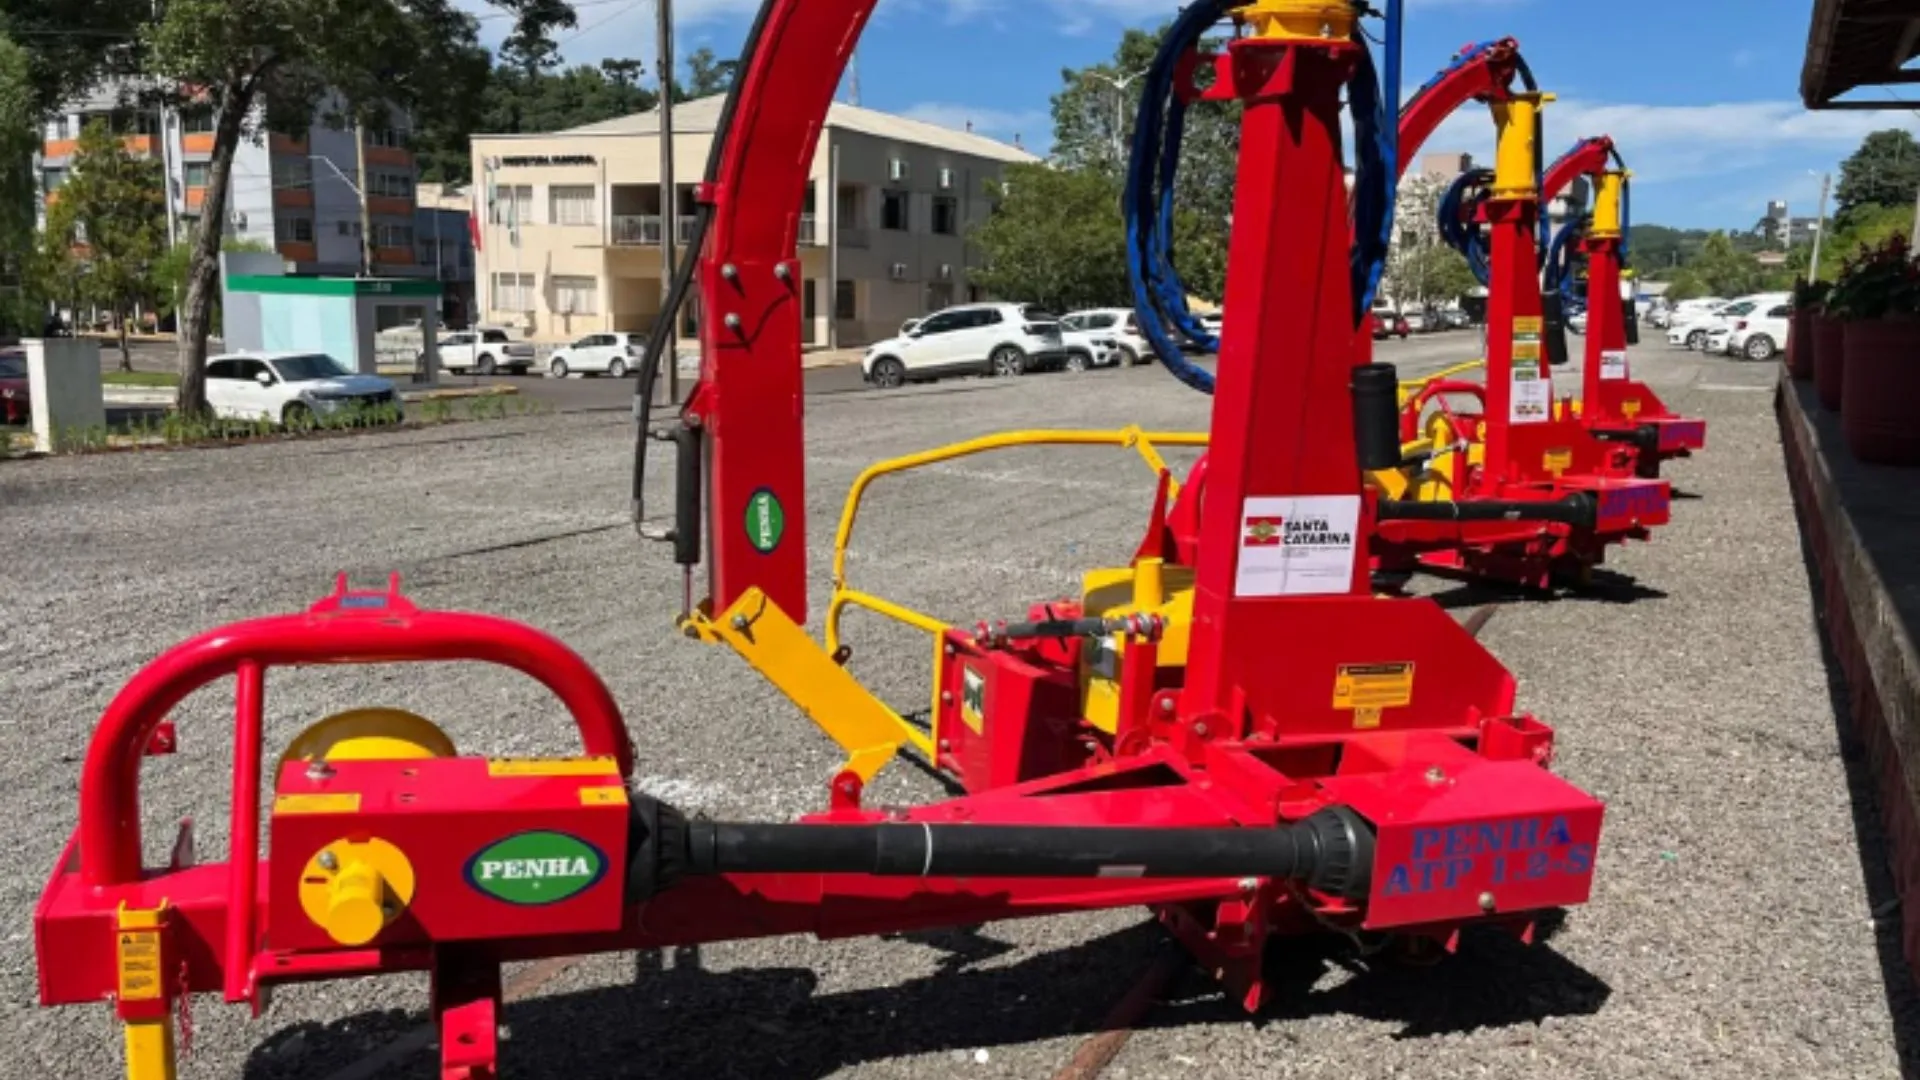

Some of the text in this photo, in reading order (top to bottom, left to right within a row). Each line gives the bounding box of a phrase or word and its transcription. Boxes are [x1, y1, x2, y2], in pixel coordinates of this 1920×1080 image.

[1284, 520, 1329, 532] SANTA
[1283, 533, 1351, 545] CATARINA
[1411, 815, 1572, 859] PENHA
[480, 855, 590, 880] PENHA
[1384, 858, 1475, 896] ATP
